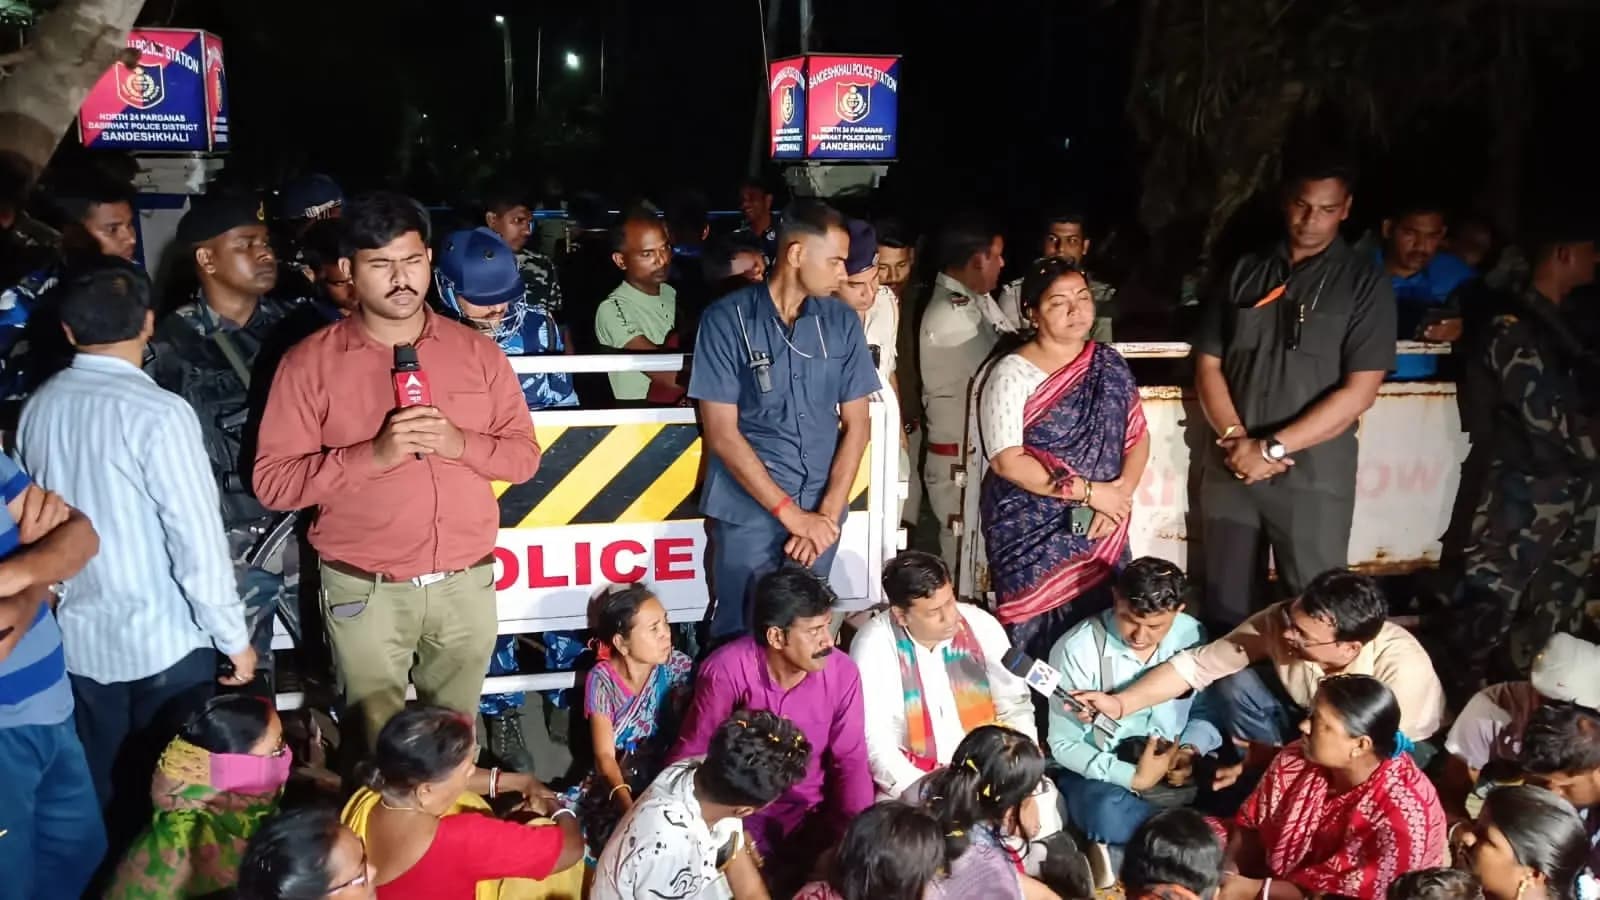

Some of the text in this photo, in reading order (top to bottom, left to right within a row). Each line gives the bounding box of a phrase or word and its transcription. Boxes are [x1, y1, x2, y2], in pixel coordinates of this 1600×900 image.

[165, 45, 199, 74] STATION
[808, 63, 852, 89] SANDESHKHALI
[852, 63, 873, 78] POLICE
[873, 68, 898, 93] STATION
[99, 113, 186, 122] NORTH 24 PARGANAS
[131, 122, 161, 130] POLICE
[162, 123, 198, 131] DISTRICT
[101, 131, 190, 142] SANDESHKHALI
[820, 142, 885, 151] SANDESHKHALI
[1356, 460, 1442, 498] OW
[494, 537, 696, 592] OLICE
